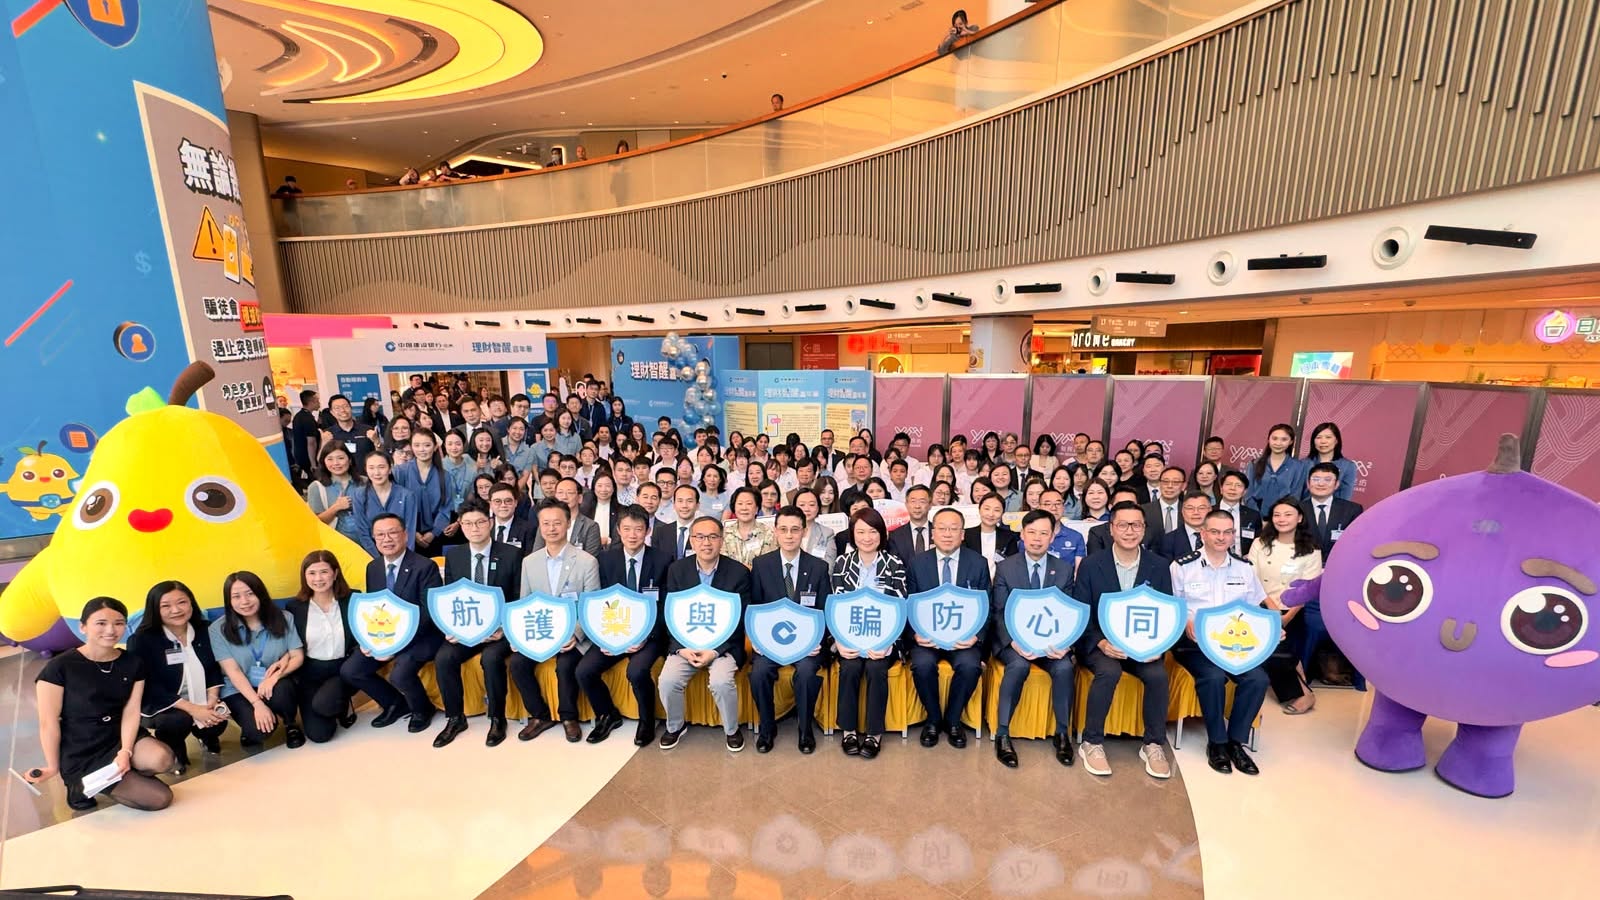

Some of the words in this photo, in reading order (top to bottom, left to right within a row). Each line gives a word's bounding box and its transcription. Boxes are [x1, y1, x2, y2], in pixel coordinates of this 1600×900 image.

[451, 596, 483, 627] 航
[523, 609, 555, 641] 護
[686, 602, 717, 634] 與
[848, 605, 882, 637] 騙
[932, 601, 964, 632] 防
[1027, 605, 1060, 638] 心
[1125, 605, 1159, 640] 同
